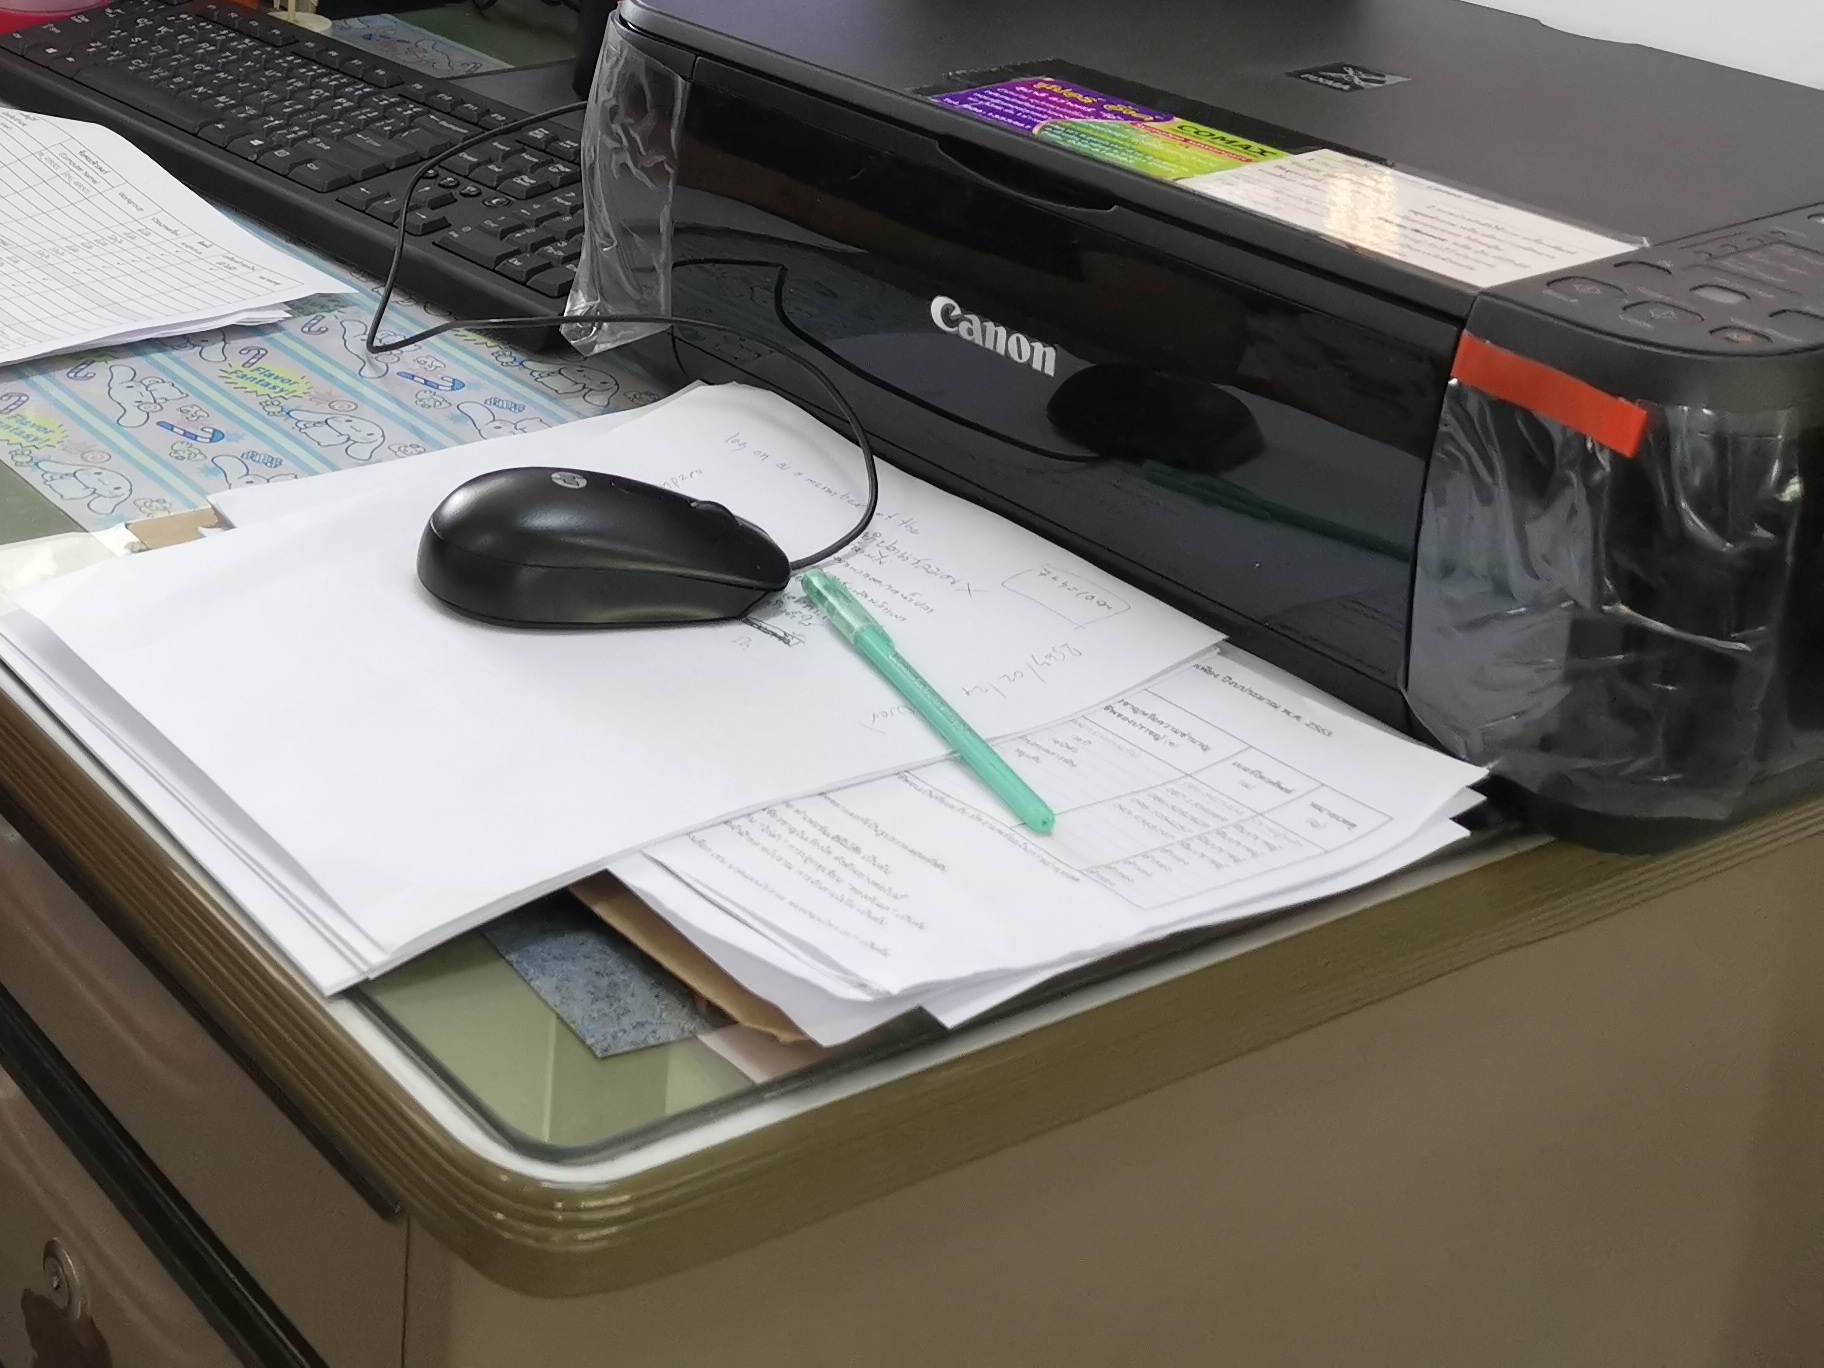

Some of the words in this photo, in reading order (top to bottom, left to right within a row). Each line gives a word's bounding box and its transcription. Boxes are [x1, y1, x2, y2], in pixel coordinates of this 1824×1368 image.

[1176, 123, 1280, 157] COMAX
[929, 294, 1058, 378] Canon
[1305, 720, 1334, 738] 2563
